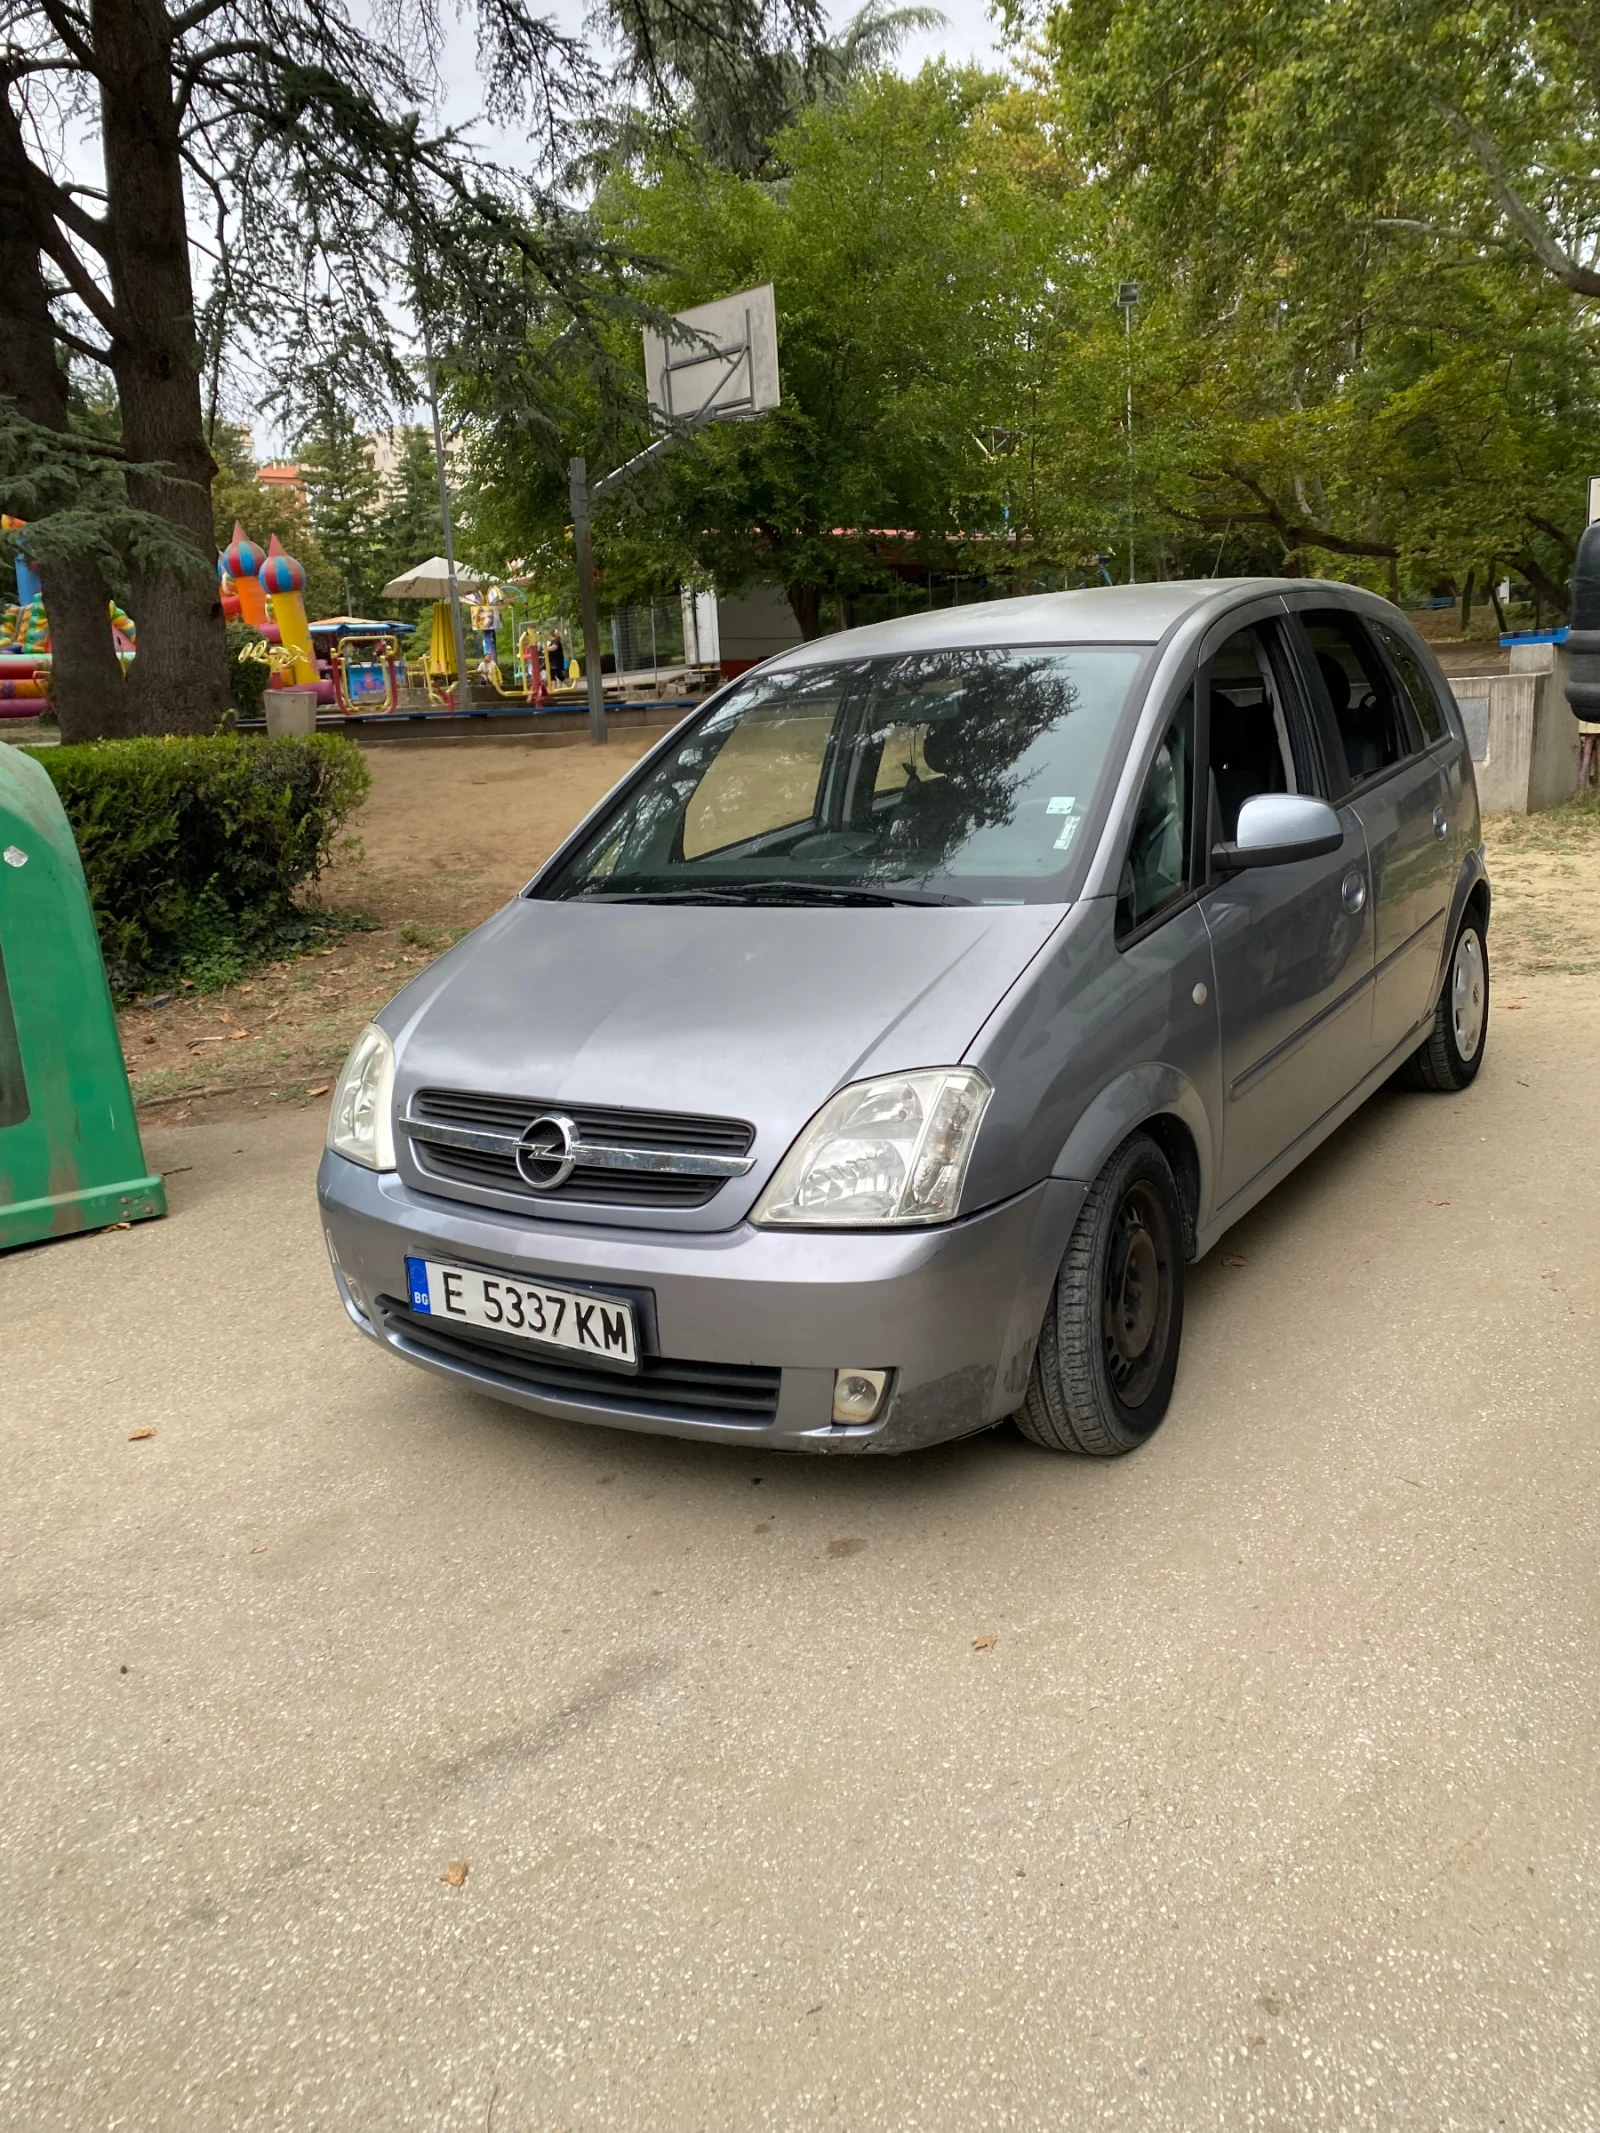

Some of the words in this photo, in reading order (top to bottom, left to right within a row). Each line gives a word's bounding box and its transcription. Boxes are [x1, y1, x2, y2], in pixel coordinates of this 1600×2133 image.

[414, 1291, 429, 1306] BG
[442, 1271, 467, 1316] E
[483, 1280, 567, 1338] 5337
[575, 1301, 628, 1354] KM
